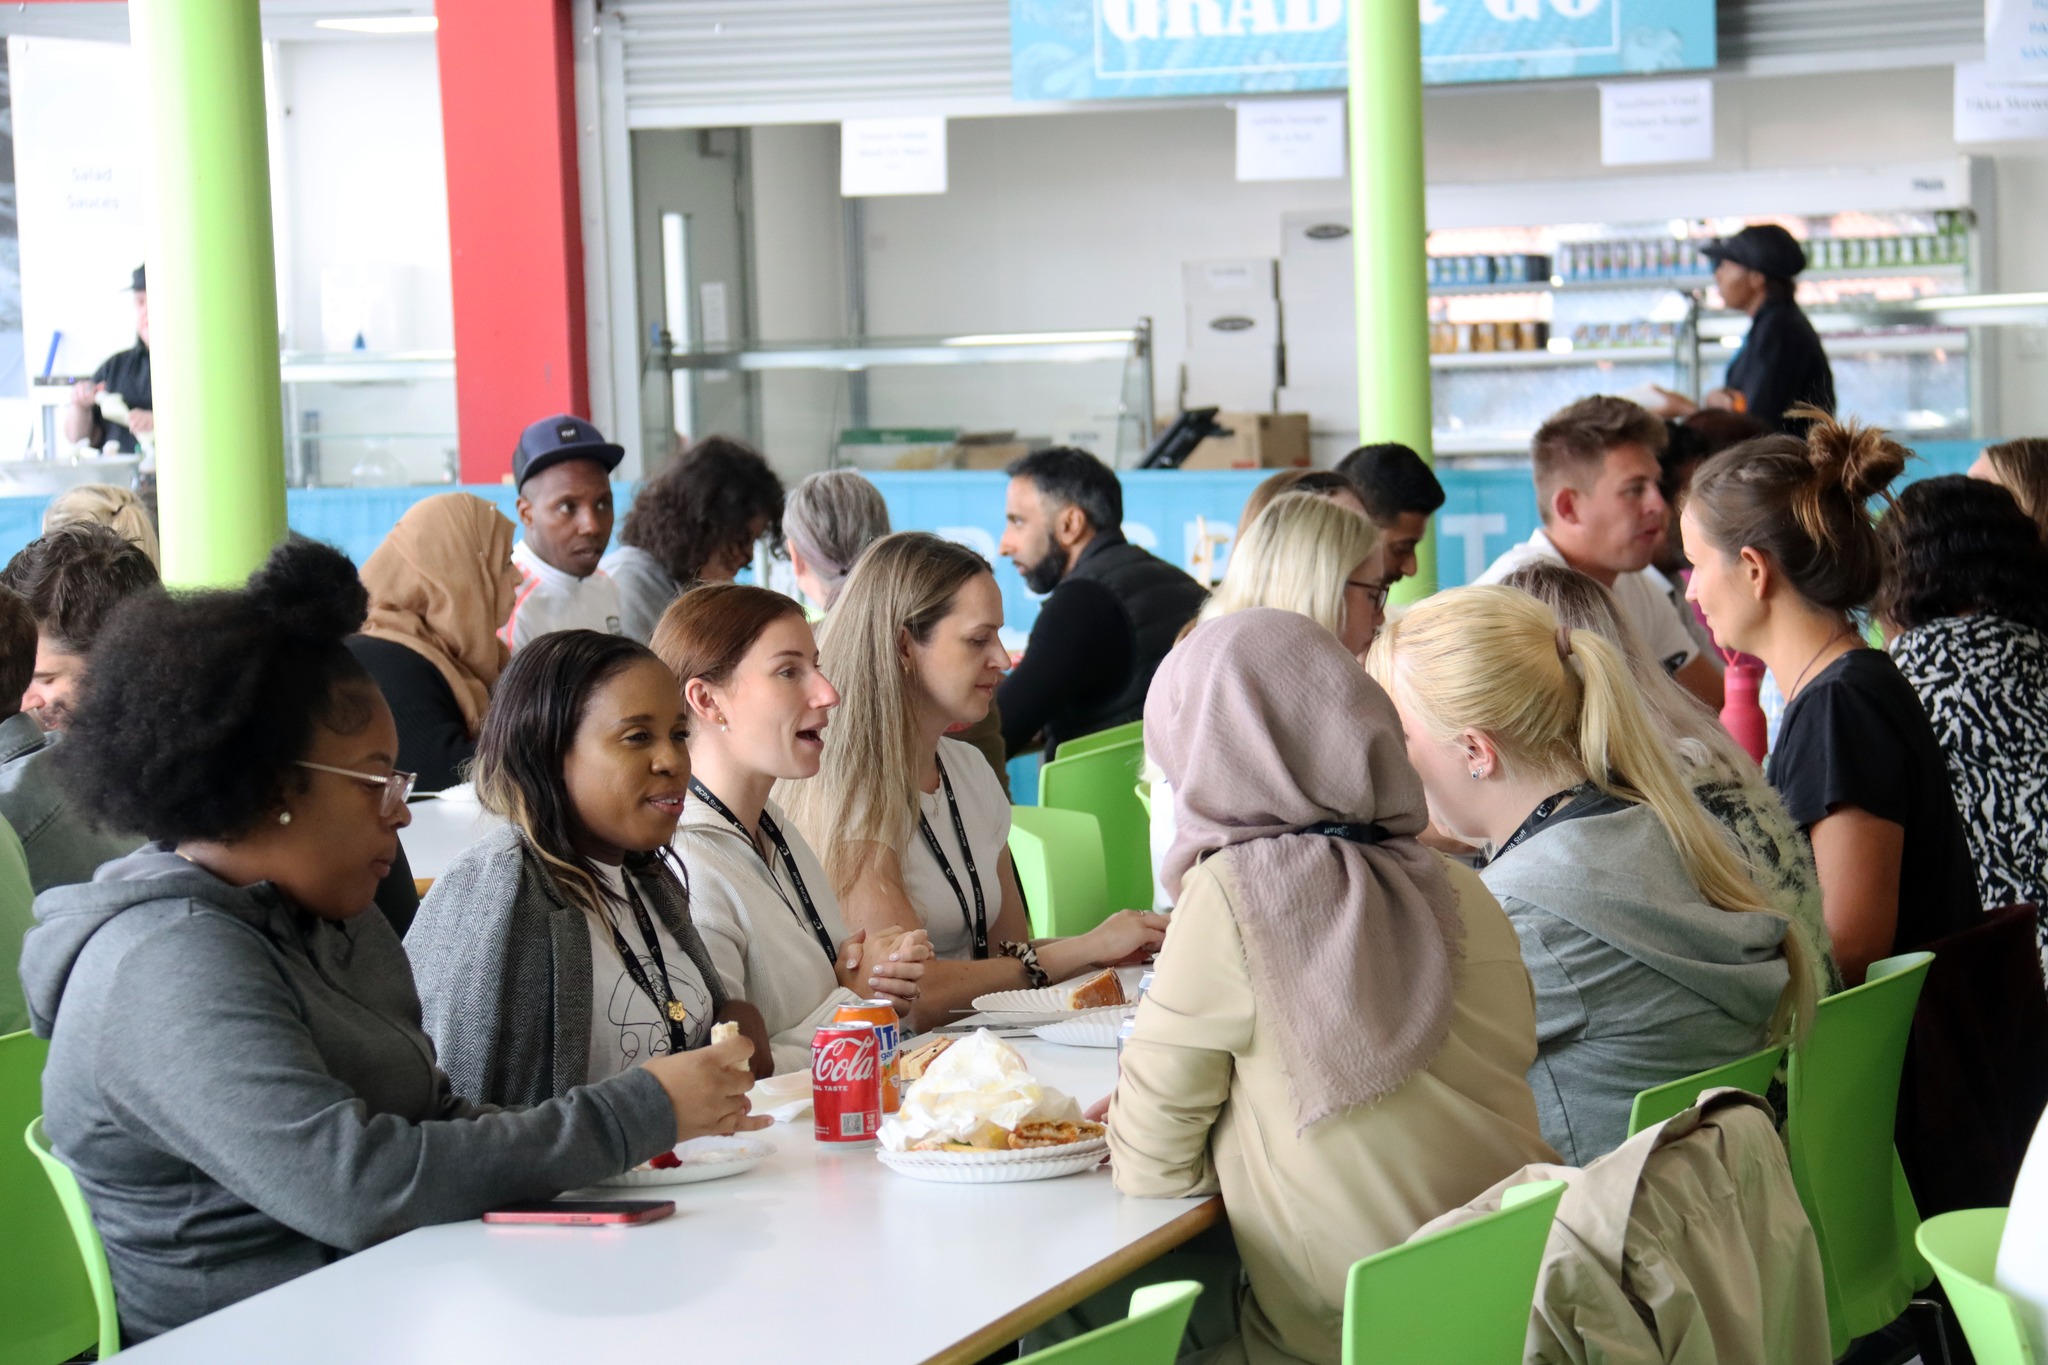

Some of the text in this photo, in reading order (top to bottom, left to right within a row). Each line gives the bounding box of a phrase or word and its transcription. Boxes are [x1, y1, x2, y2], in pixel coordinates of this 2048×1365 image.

[694, 784, 723, 812] MCPA Staff
[1324, 826, 1343, 835] Staff
[1513, 829, 1527, 845] Staff
[800, 885, 810, 905] MCPA
